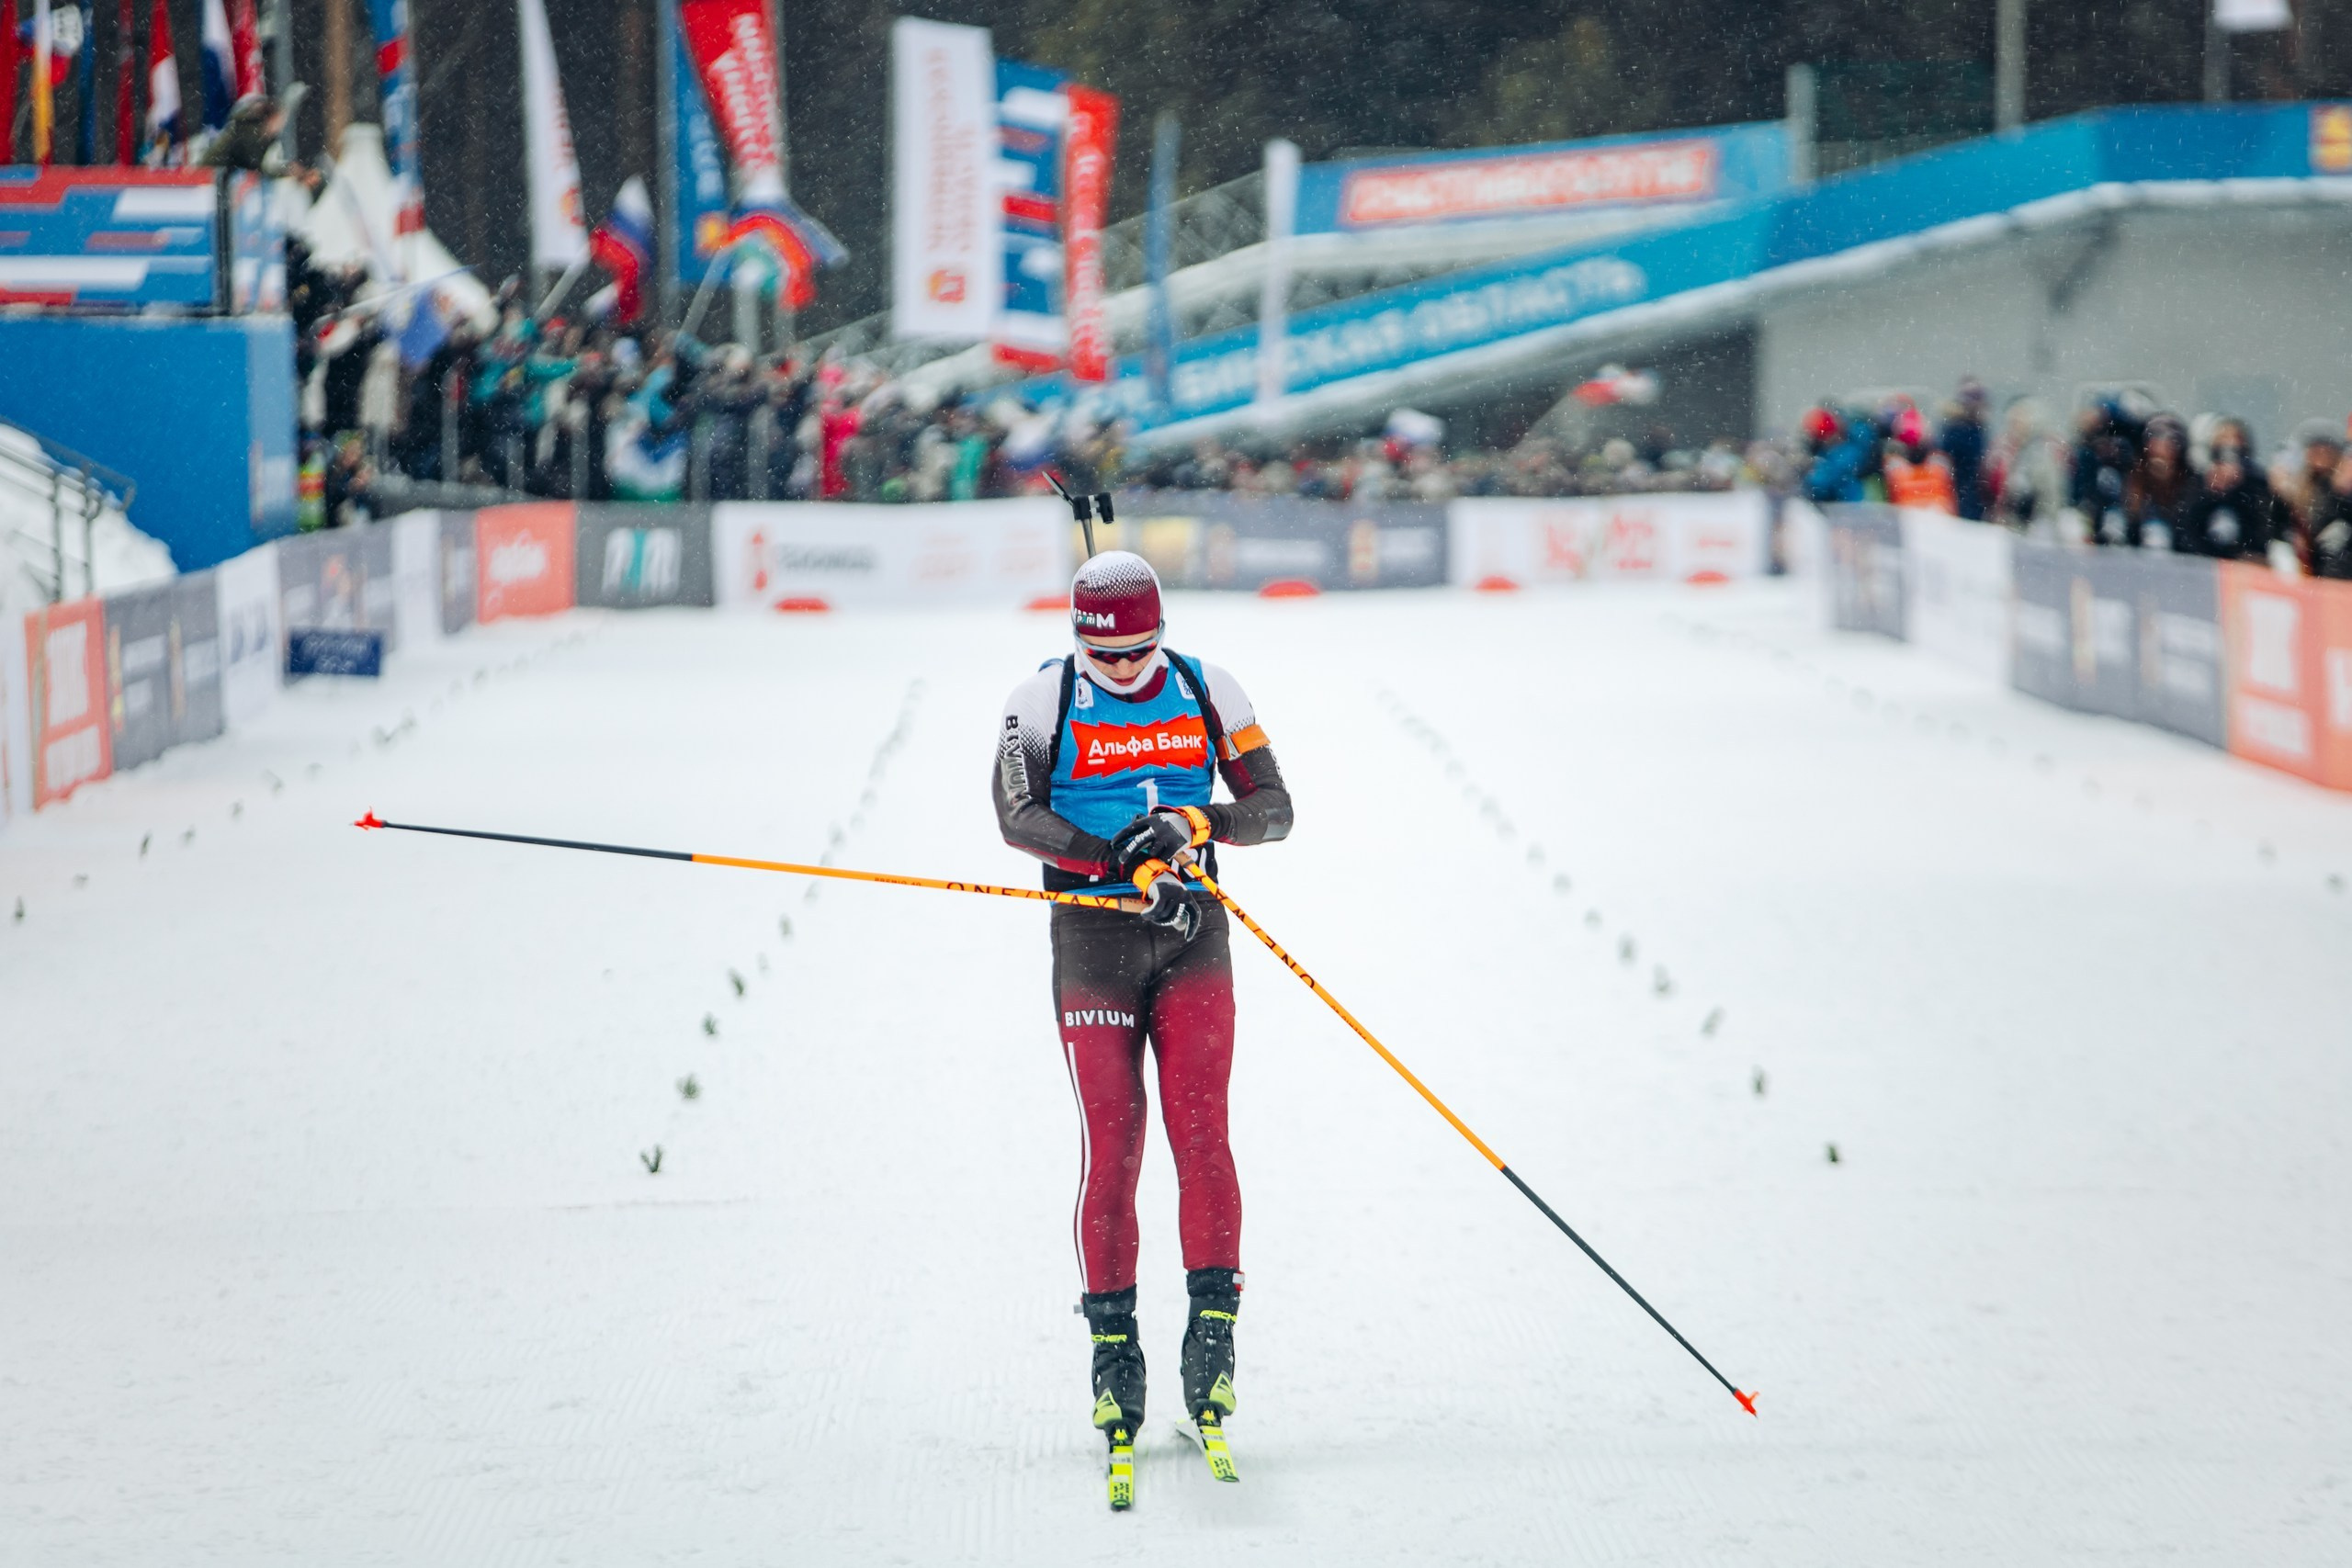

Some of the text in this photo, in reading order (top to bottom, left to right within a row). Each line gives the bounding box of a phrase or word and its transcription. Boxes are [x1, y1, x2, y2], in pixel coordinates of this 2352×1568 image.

[1088, 732, 1203, 762] Альфа Банк
[1136, 778, 1159, 816] 1
[1064, 1010, 1135, 1028] BIVIUM
